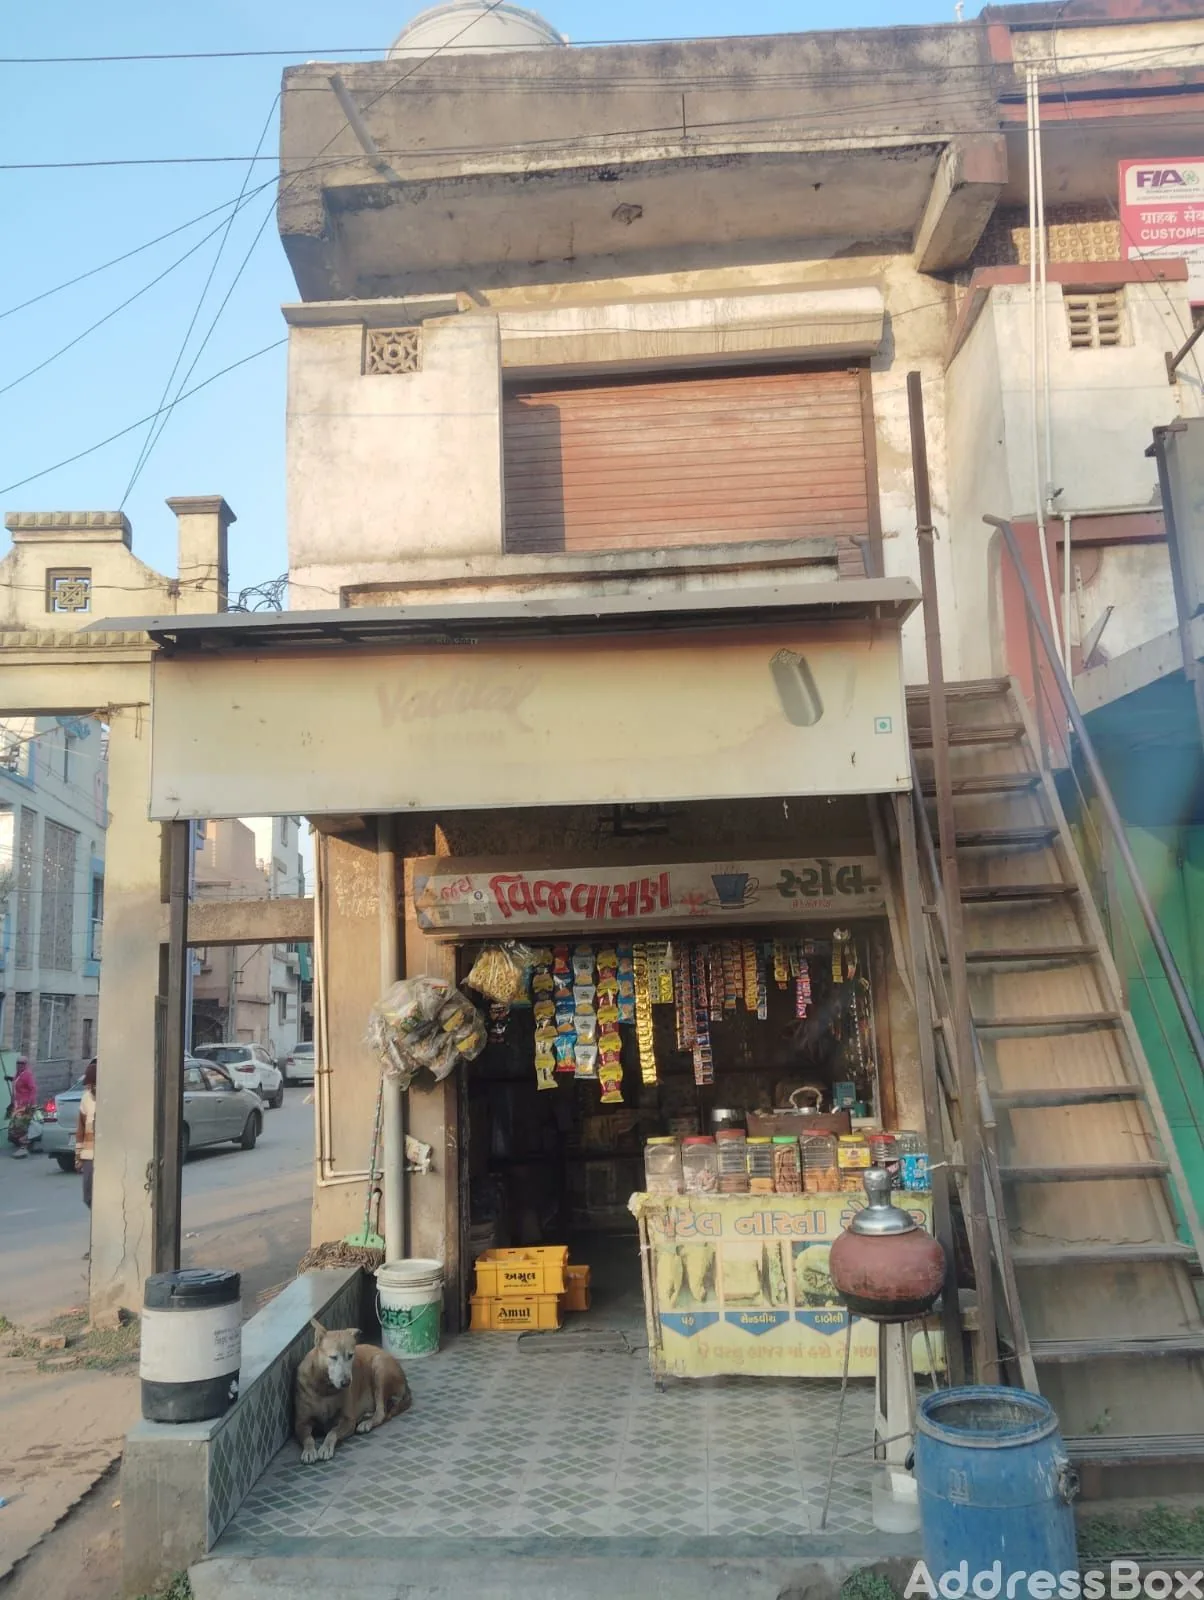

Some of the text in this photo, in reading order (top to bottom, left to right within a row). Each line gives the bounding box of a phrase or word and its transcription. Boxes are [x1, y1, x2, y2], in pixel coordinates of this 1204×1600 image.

[1136, 169, 1187, 188] FIA
[1140, 211, 1178, 225] ग्राहक
[1141, 227, 1204, 240] CUSTOME
[734, 1209, 827, 1236] નાસ્તા
[503, 1272, 537, 1284] અમૂલ
[496, 1306, 531, 1319] Amul
